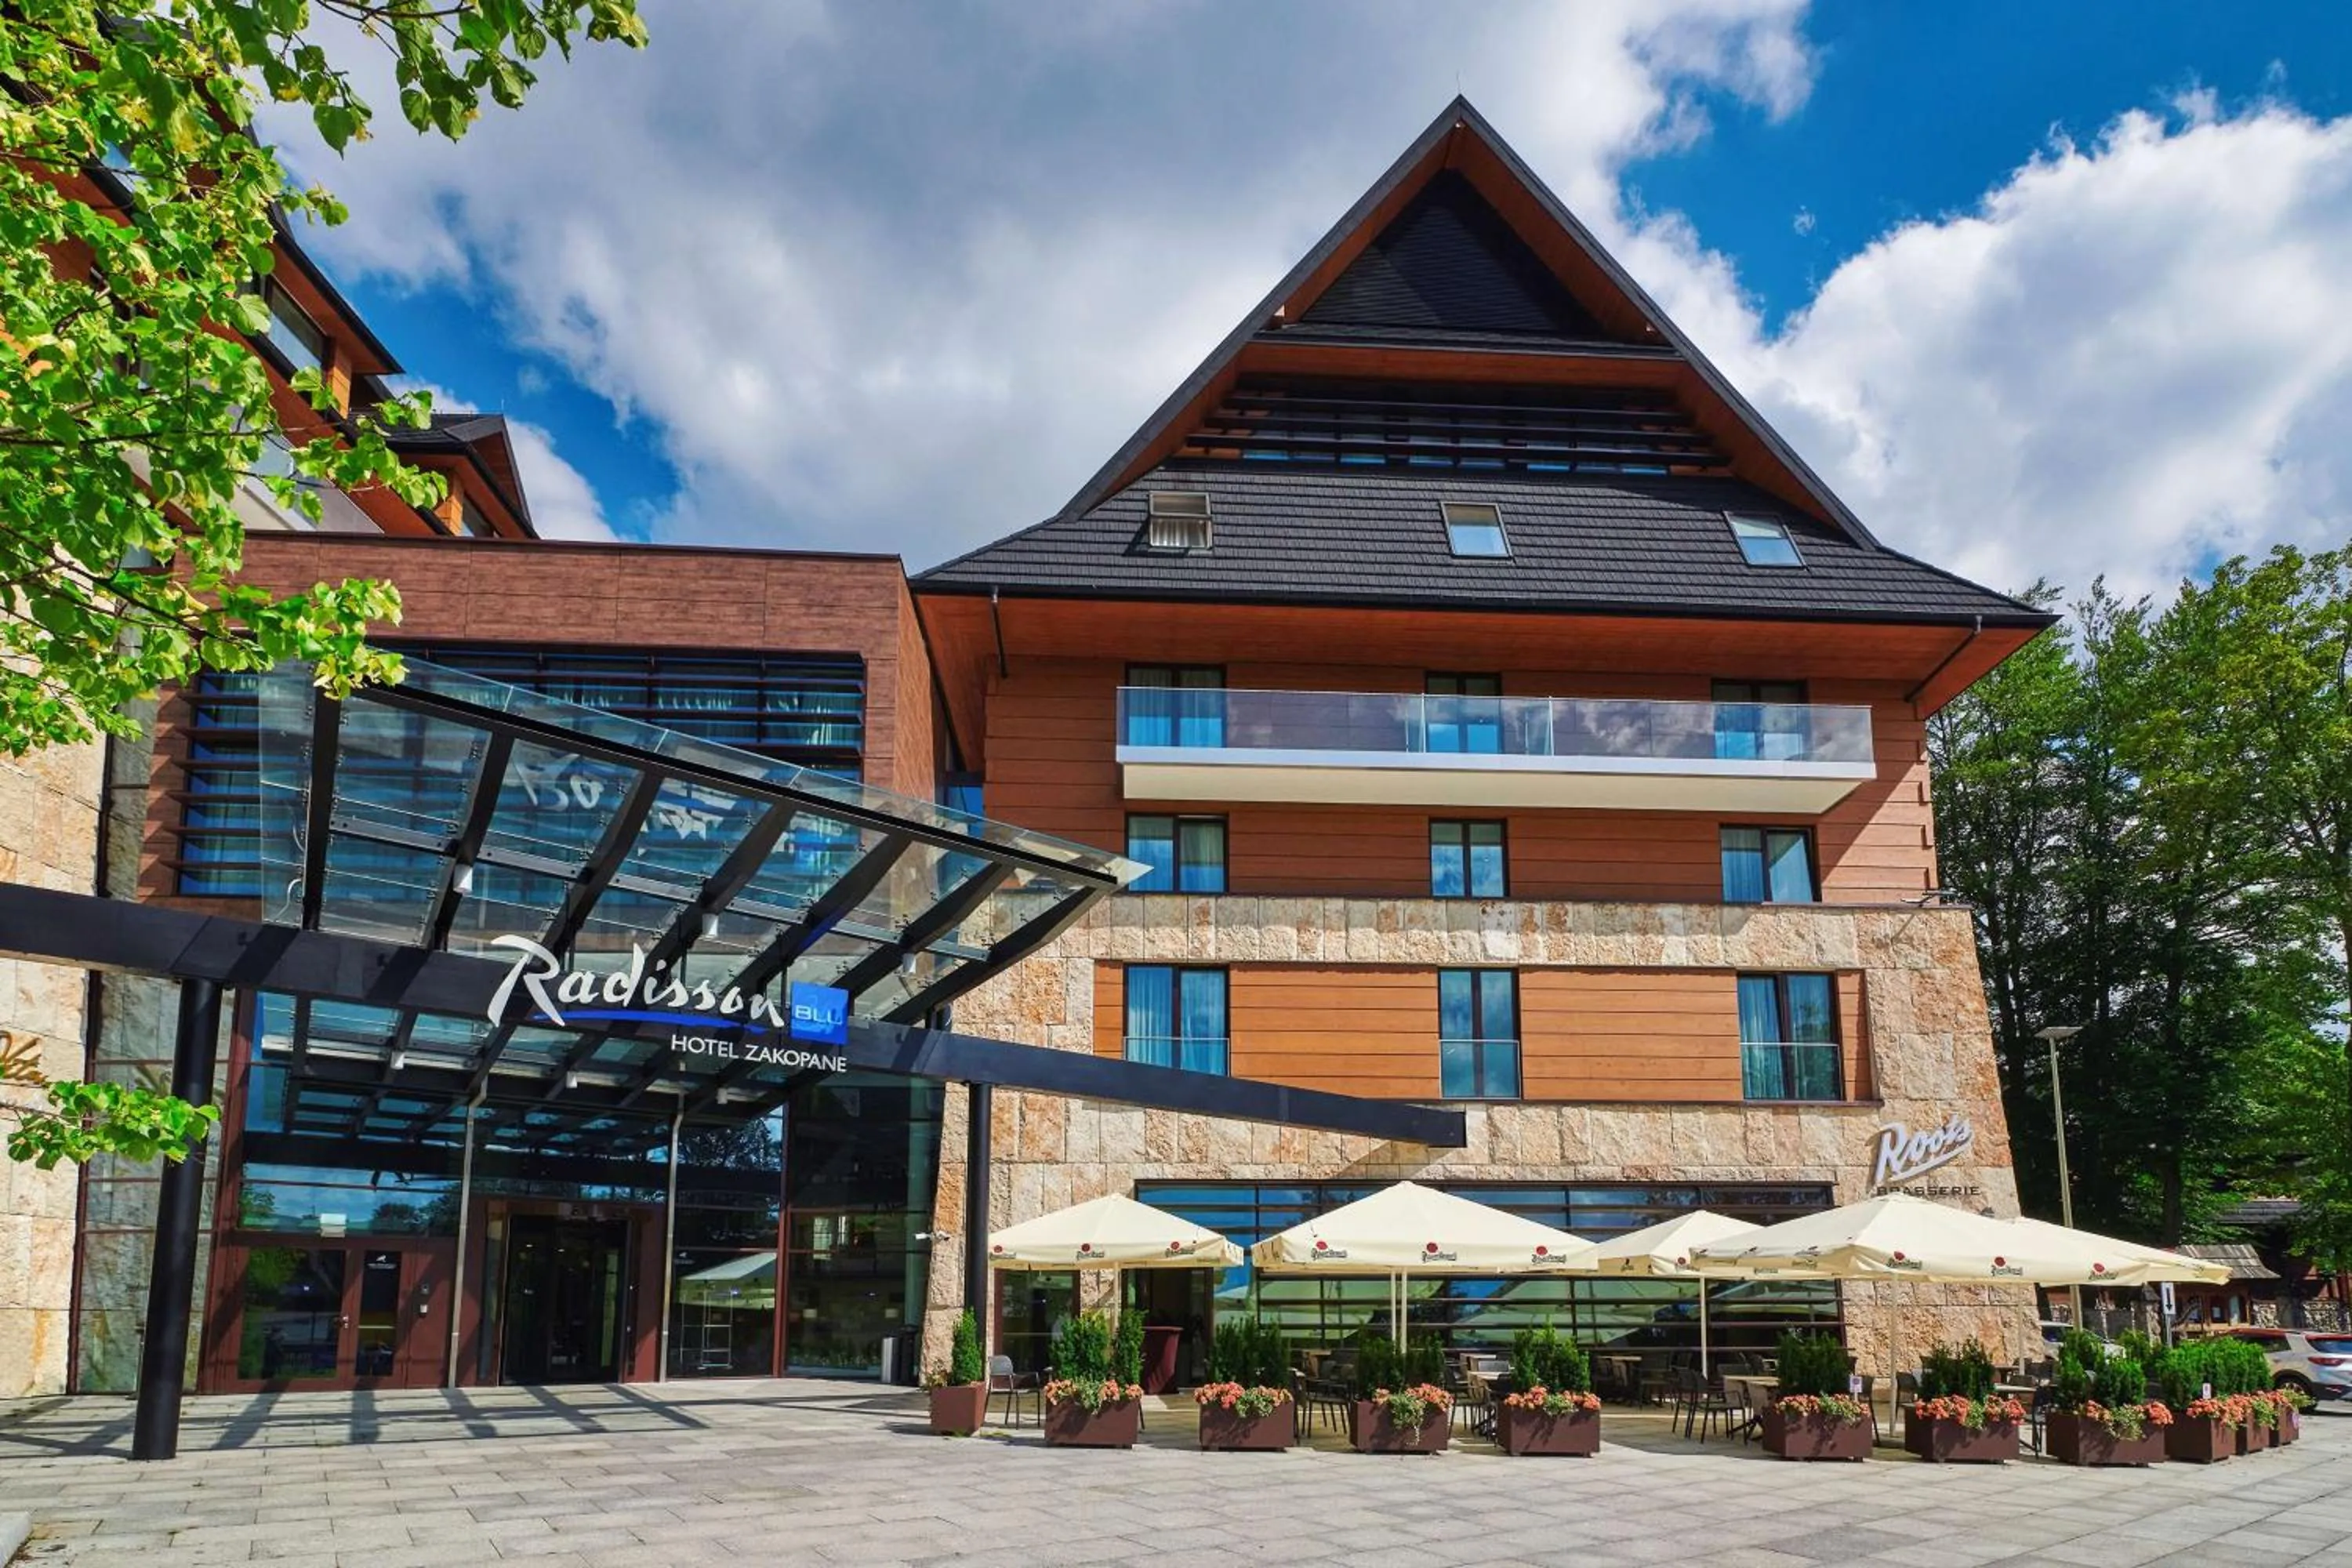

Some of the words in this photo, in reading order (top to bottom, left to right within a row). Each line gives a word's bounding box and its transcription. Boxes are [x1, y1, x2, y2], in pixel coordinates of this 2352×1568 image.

[487, 934, 785, 1027] Radisson
[795, 1004, 844, 1025] BLU
[671, 1034, 739, 1058] HOTEL
[746, 1044, 848, 1073] ZAKOPANE
